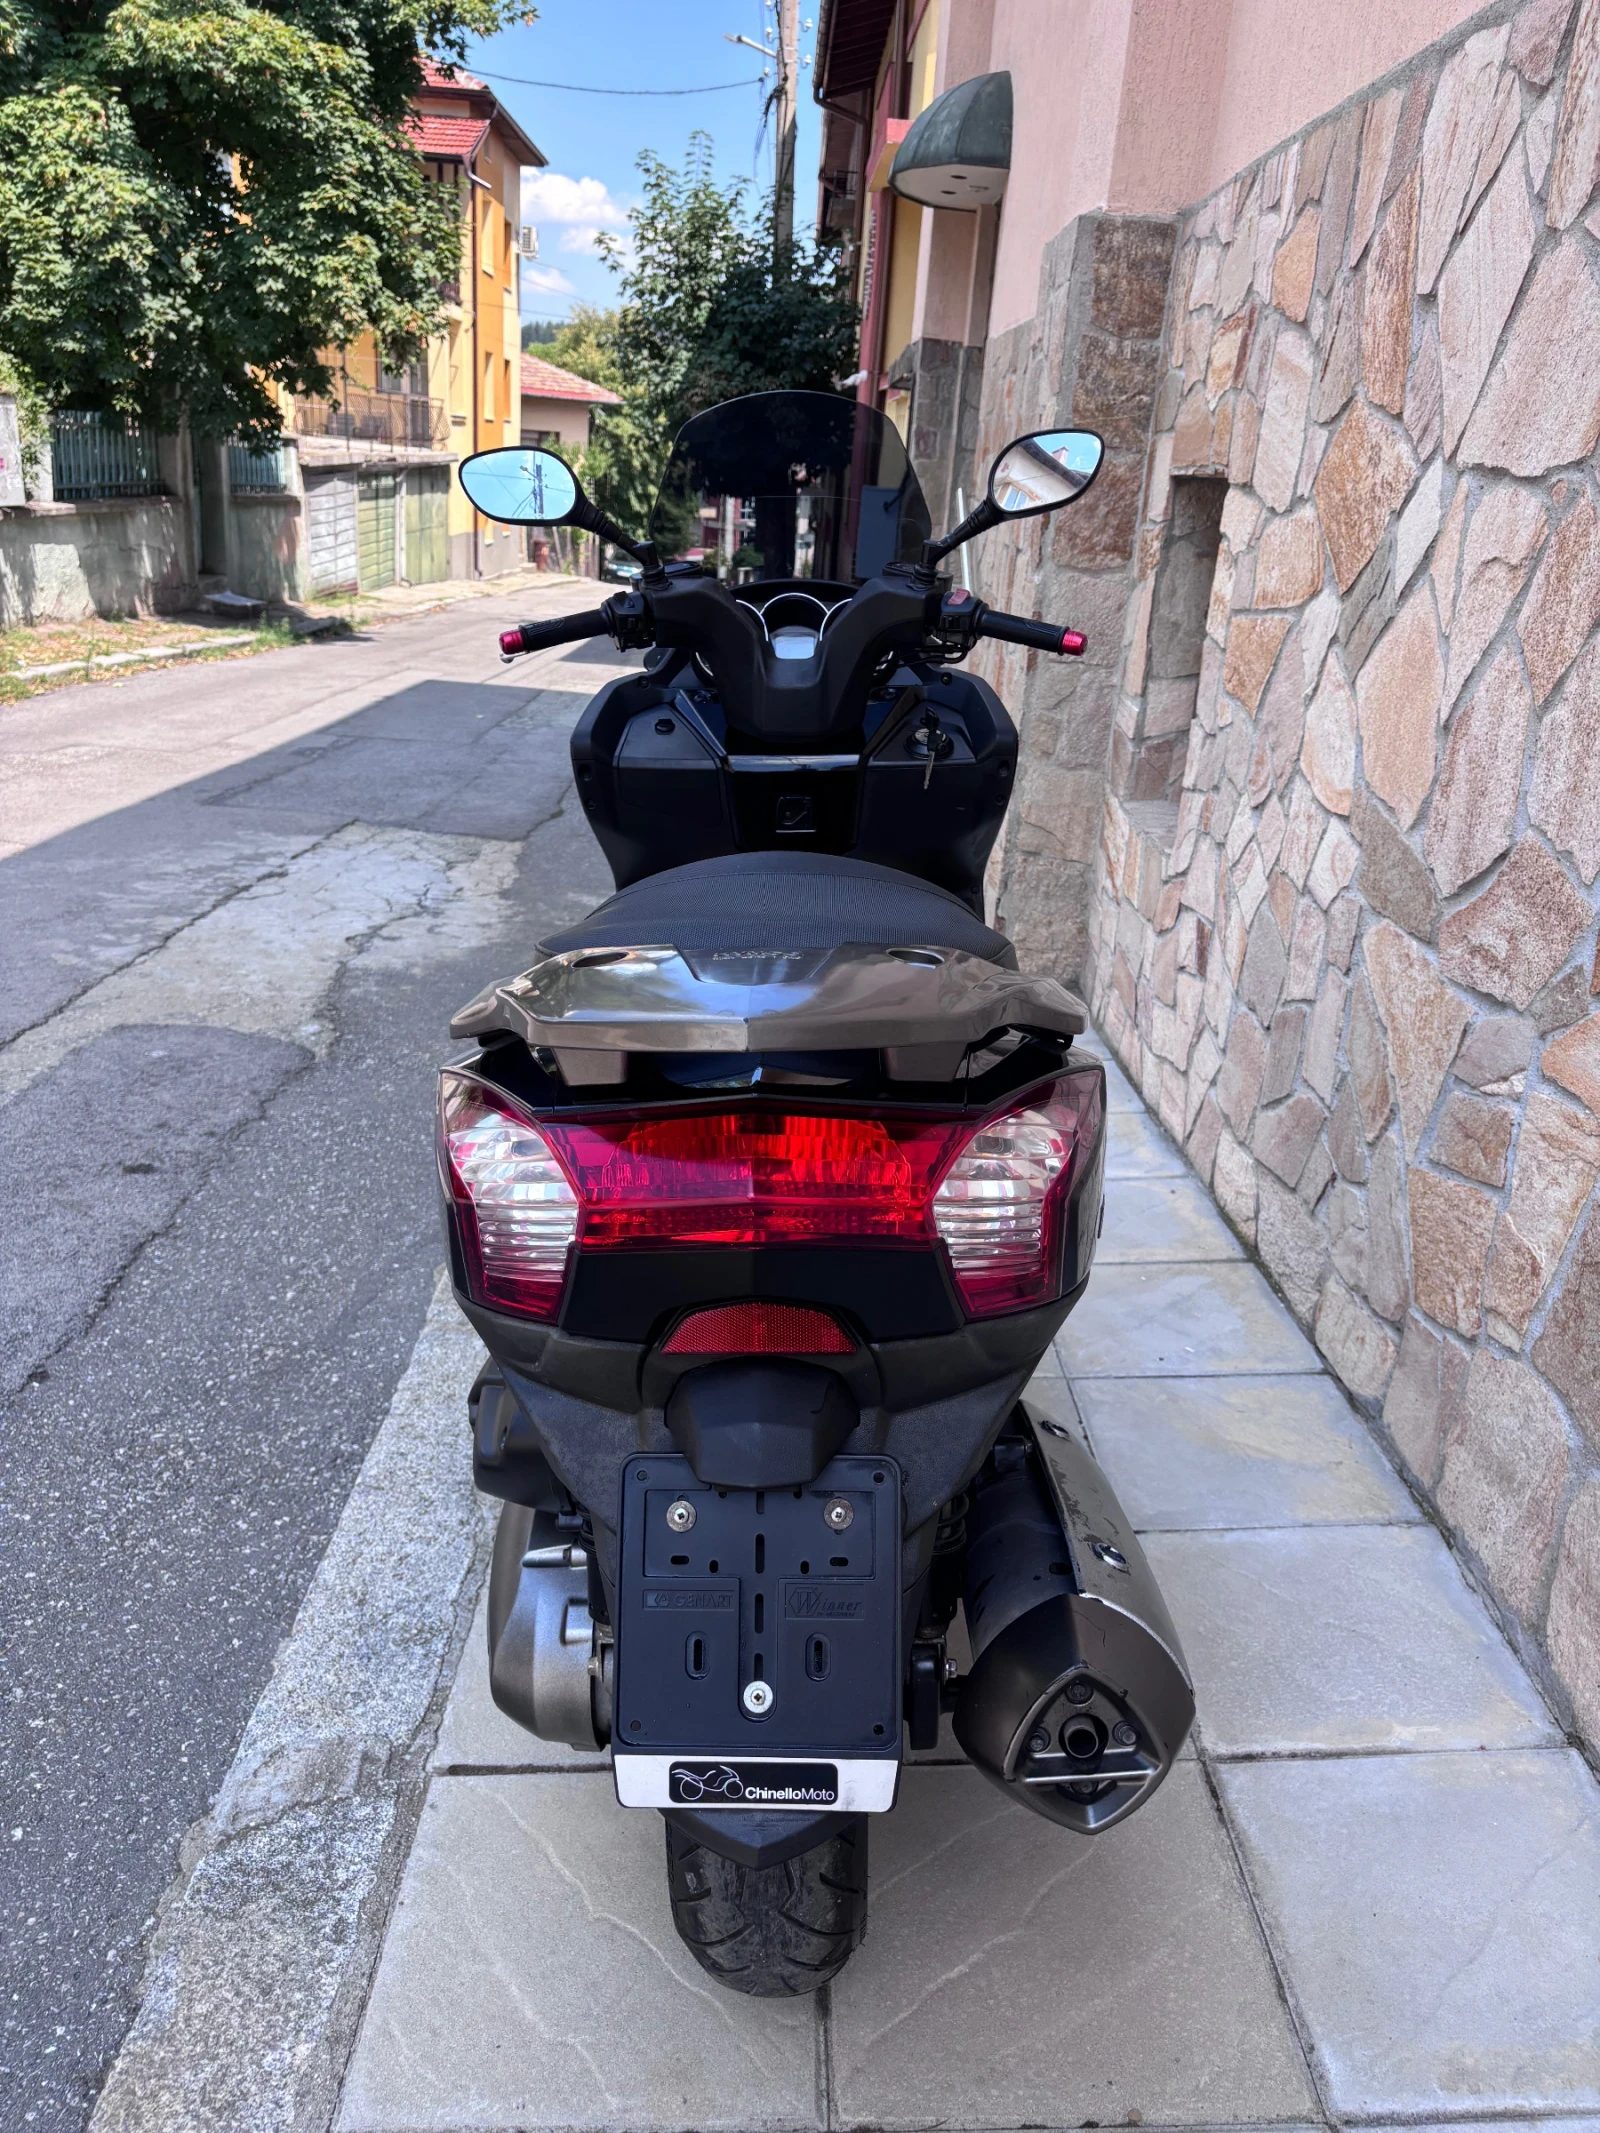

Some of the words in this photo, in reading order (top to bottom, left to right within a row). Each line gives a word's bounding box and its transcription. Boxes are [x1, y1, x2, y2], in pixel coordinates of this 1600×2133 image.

[674, 1593, 733, 1607] GENART
[796, 1590, 862, 1614] Winner
[745, 1786, 835, 1801] ChinelloMoto
